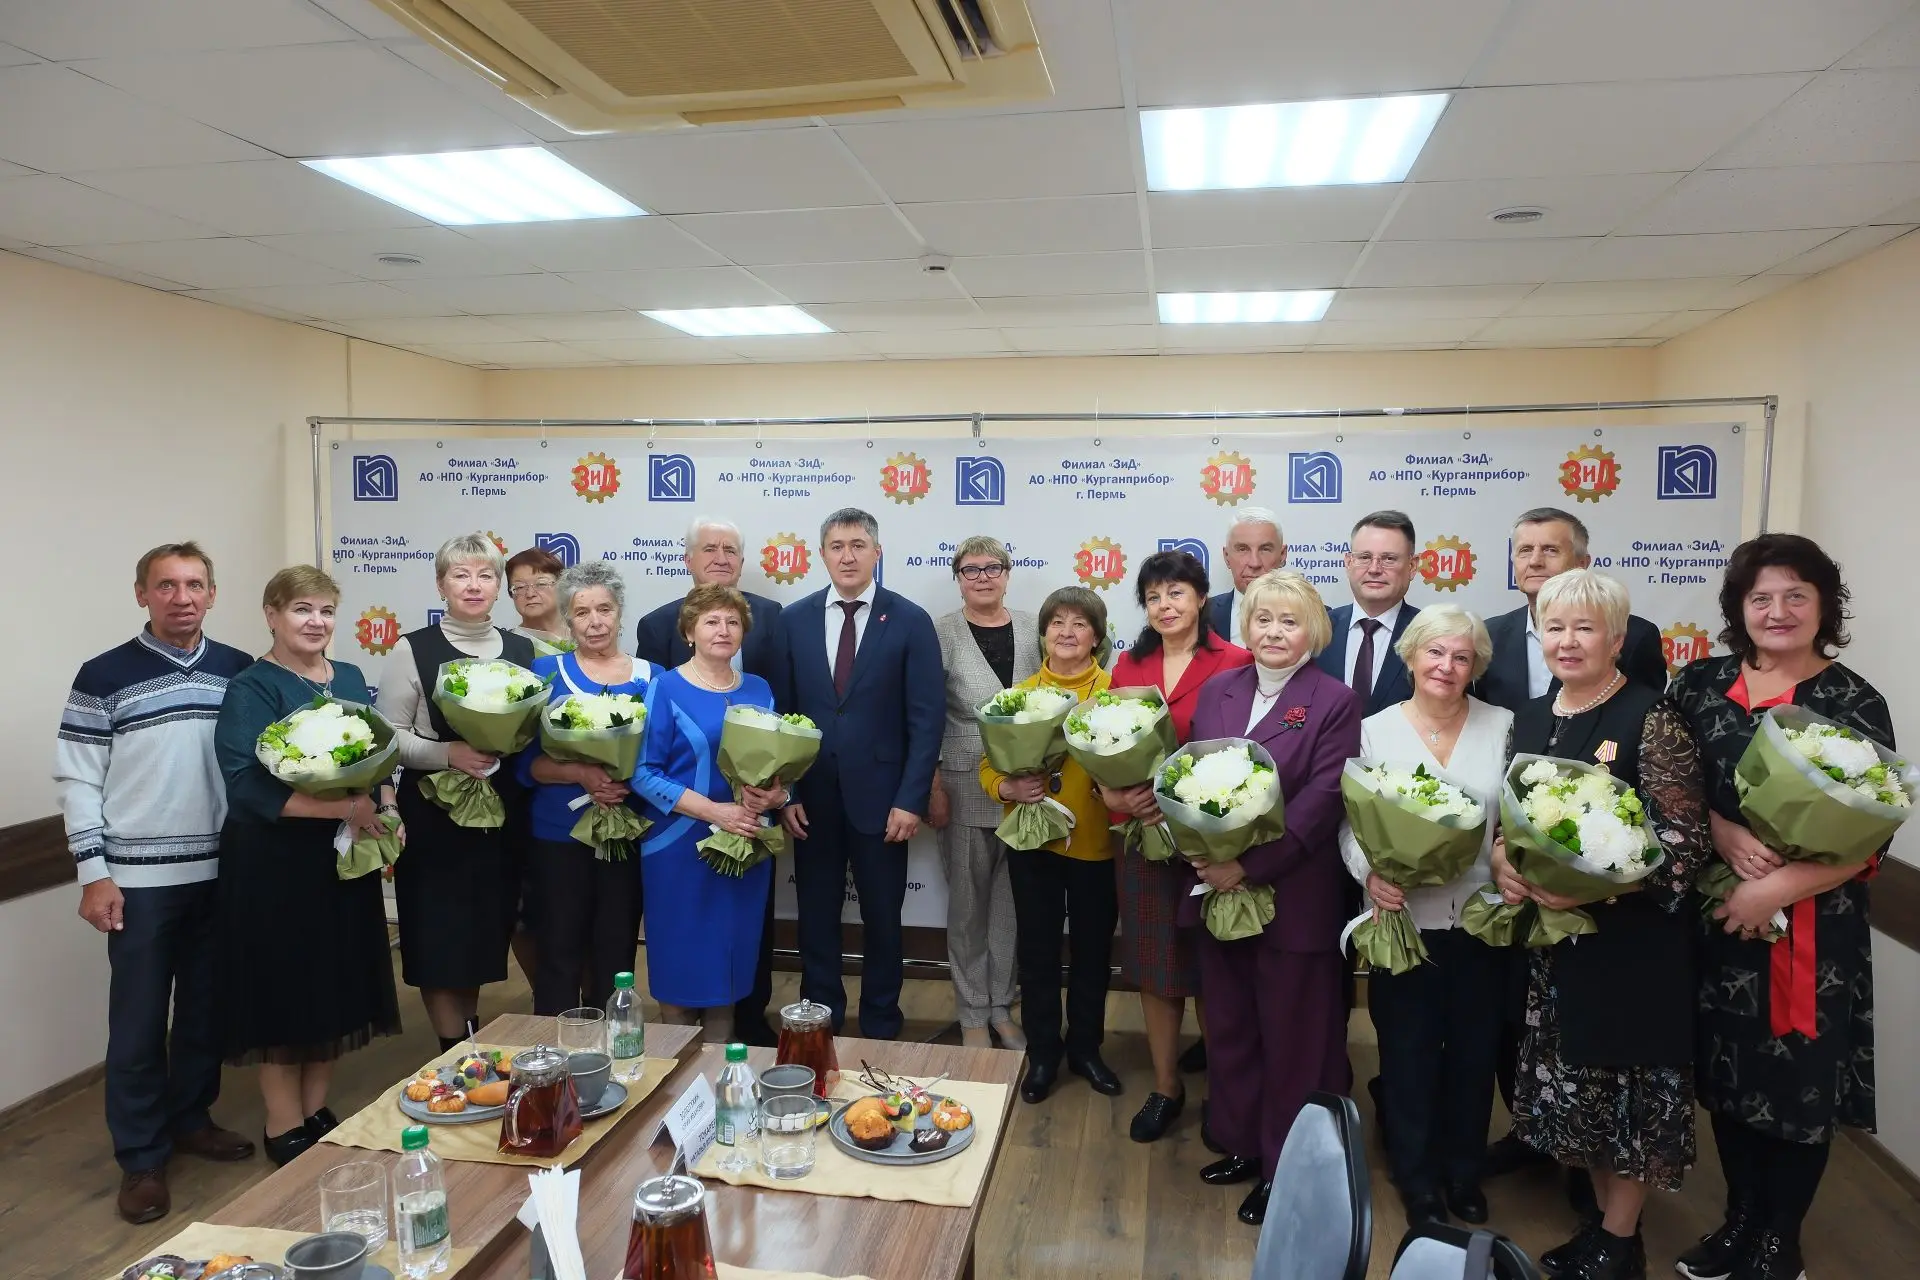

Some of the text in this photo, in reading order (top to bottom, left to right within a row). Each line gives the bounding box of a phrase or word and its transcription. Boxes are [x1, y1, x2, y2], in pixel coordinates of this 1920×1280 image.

[448, 458, 520, 469] Филиал «ЗиД»
[749, 458, 825, 469] Филиал «ЗиД»
[1061, 459, 1141, 470] Филиал «ЗиД»
[1405, 453, 1493, 466] Филиал «ЗиД»
[419, 471, 549, 484] АО «НПО «Курганприбор»
[574, 464, 618, 493] ЗиД
[718, 472, 856, 485] АО «НПО «Курганприбор»
[882, 464, 931, 493] ЗиД
[1028, 474, 1175, 487] АО «НПО «Курганприбор»
[1202, 464, 1253, 494] ЗиД
[1369, 469, 1530, 483] АО «НПО «Курганприбор»
[1561, 459, 1617, 490] ЗиД
[461, 486, 507, 497] г. Пермь
[763, 486, 811, 498] г. Пермь
[1076, 489, 1126, 501] г. Пермь
[1421, 485, 1477, 498] г. Пермь
[340, 535, 410, 546] Филиал «ЗиД»
[632, 537, 673, 547] Филиал
[1631, 540, 1725, 552] Филиал «ЗиД»
[1287, 544, 1317, 553] лиал
[602, 551, 617, 561] АО
[620, 551, 648, 561] «НПО
[763, 545, 810, 577] ЗиД
[906, 557, 922, 566] АО
[353, 563, 397, 574] г. Пермь
[1075, 550, 1124, 579] ЗиД
[1420, 549, 1474, 580] ЗиД
[1593, 556, 1730, 570] АО «НПО «Курганпри
[646, 568, 653, 576] г.
[1300, 573, 1338, 585] ермь
[1648, 573, 1707, 585] г. Пермь
